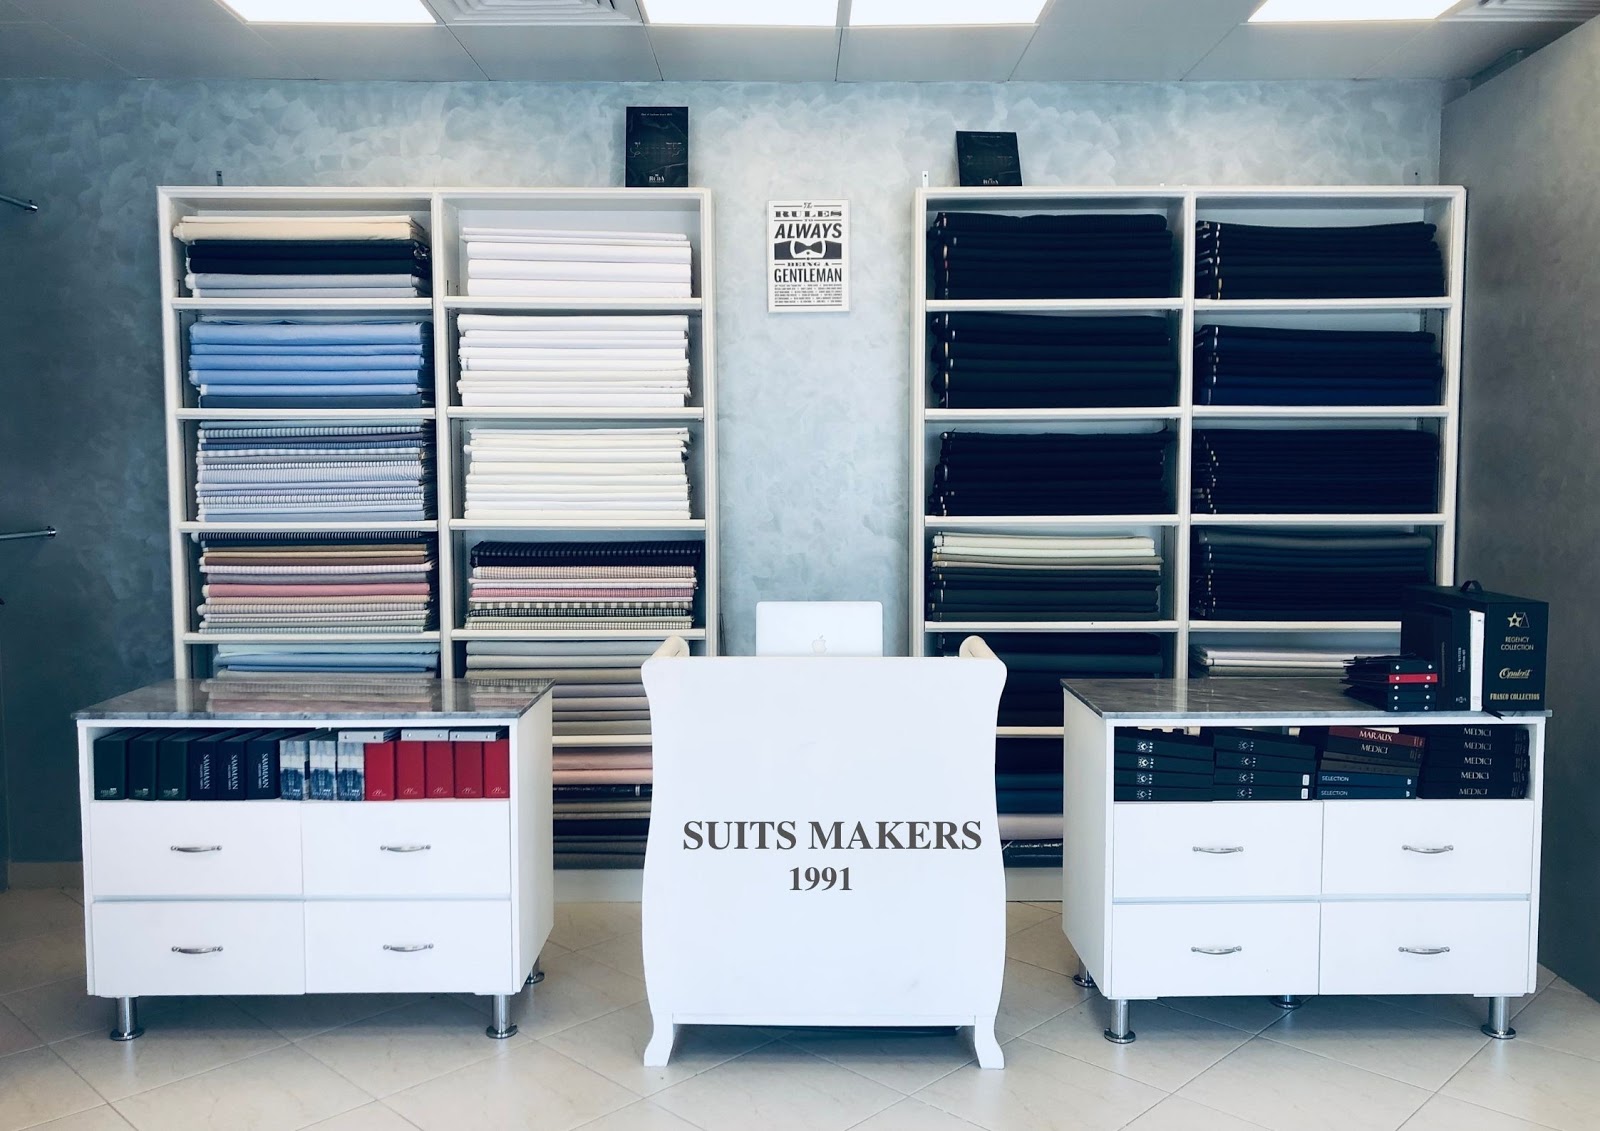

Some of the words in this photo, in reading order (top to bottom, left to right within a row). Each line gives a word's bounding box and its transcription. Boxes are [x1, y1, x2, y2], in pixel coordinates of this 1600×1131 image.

[774, 223, 842, 239] ALWAYS
[774, 268, 842, 283] GENTLEMAN
[1359, 730, 1393, 742] MARAUX
[1463, 727, 1492, 736] MEDICI
[1361, 743, 1389, 754] MEDICI
[1464, 742, 1492, 750] MEDICI
[1464, 757, 1492, 765] MEDICI
[1461, 772, 1489, 780] MEDICI
[683, 820, 796, 850] SUITS
[809, 820, 982, 850] MAKERS
[789, 867, 853, 891] 1991
